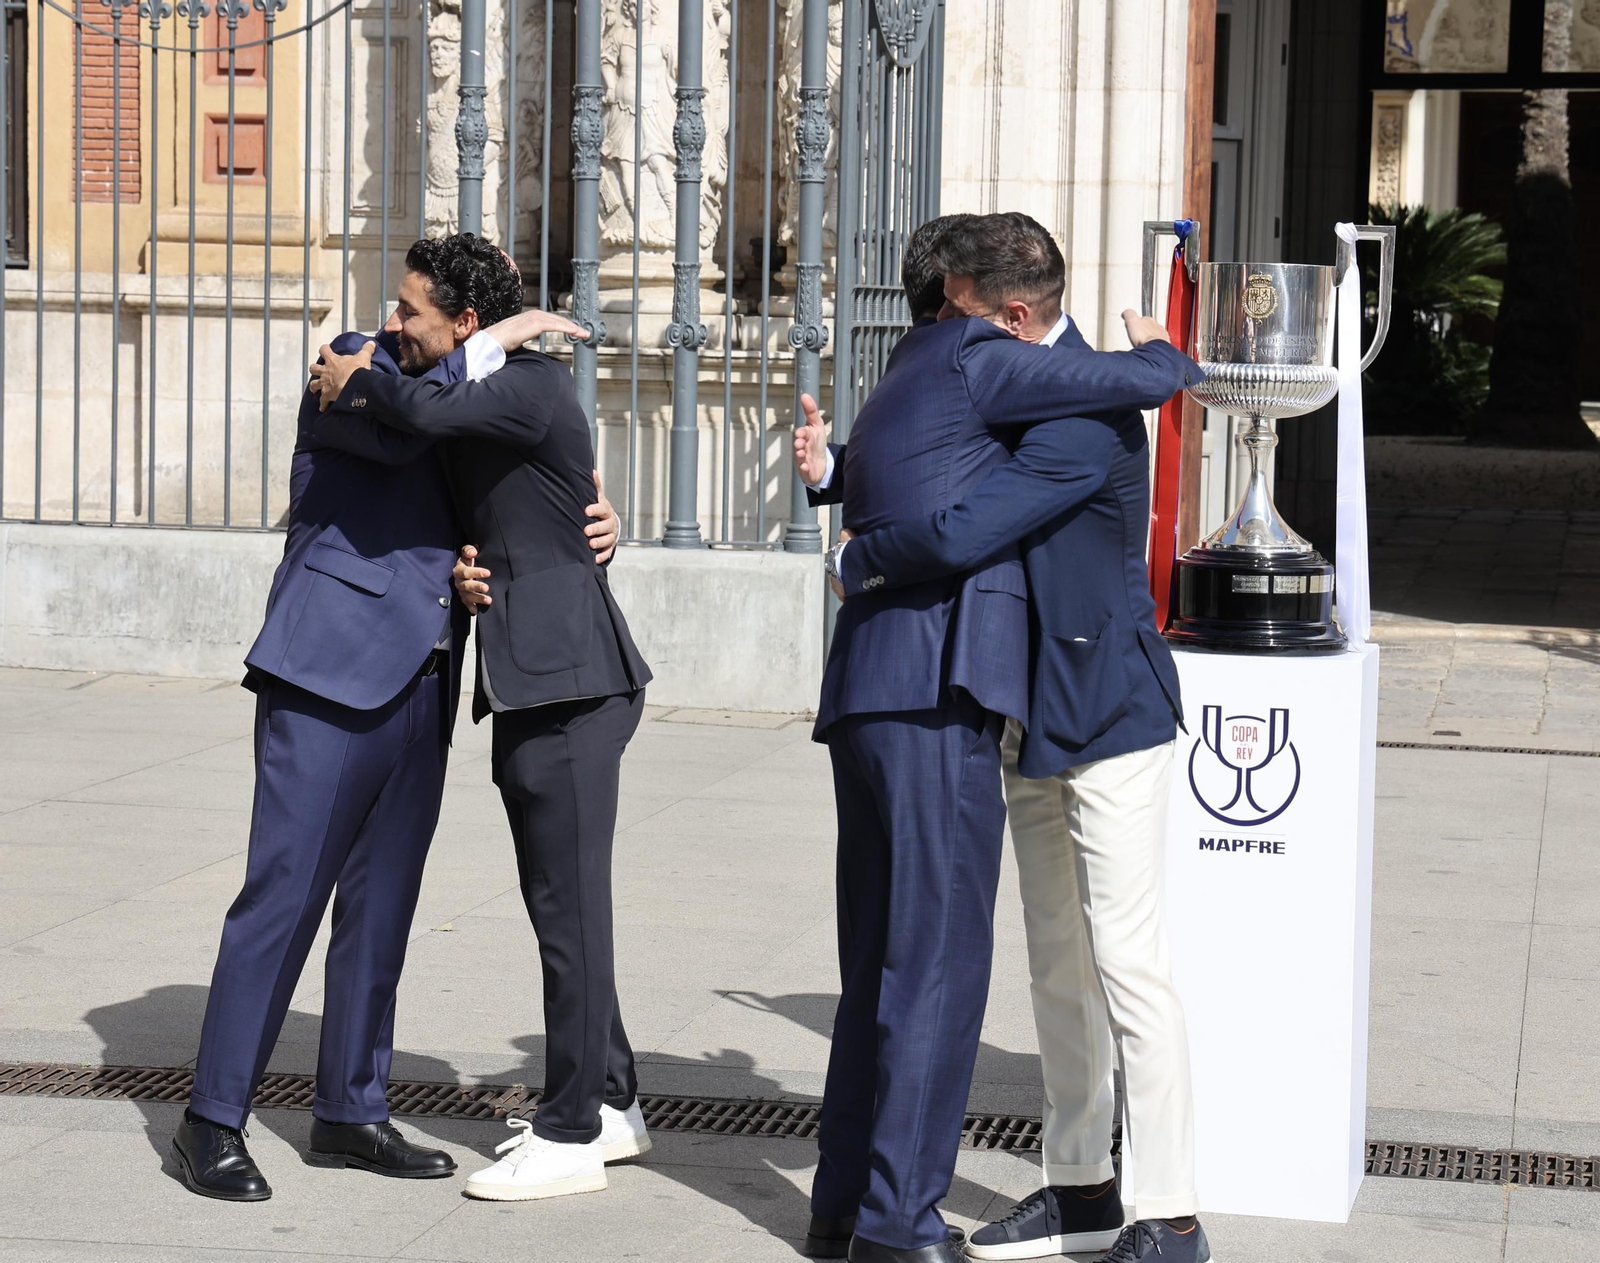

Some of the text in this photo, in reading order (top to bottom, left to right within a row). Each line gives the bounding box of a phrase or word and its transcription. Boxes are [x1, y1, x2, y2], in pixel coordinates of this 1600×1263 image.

[1266, 336, 1282, 345] DE
[1275, 348, 1289, 357] EL
[1232, 725, 1258, 742] COPA
[1236, 747, 1253, 760] REY
[1199, 838, 1285, 855] MAPFRE
